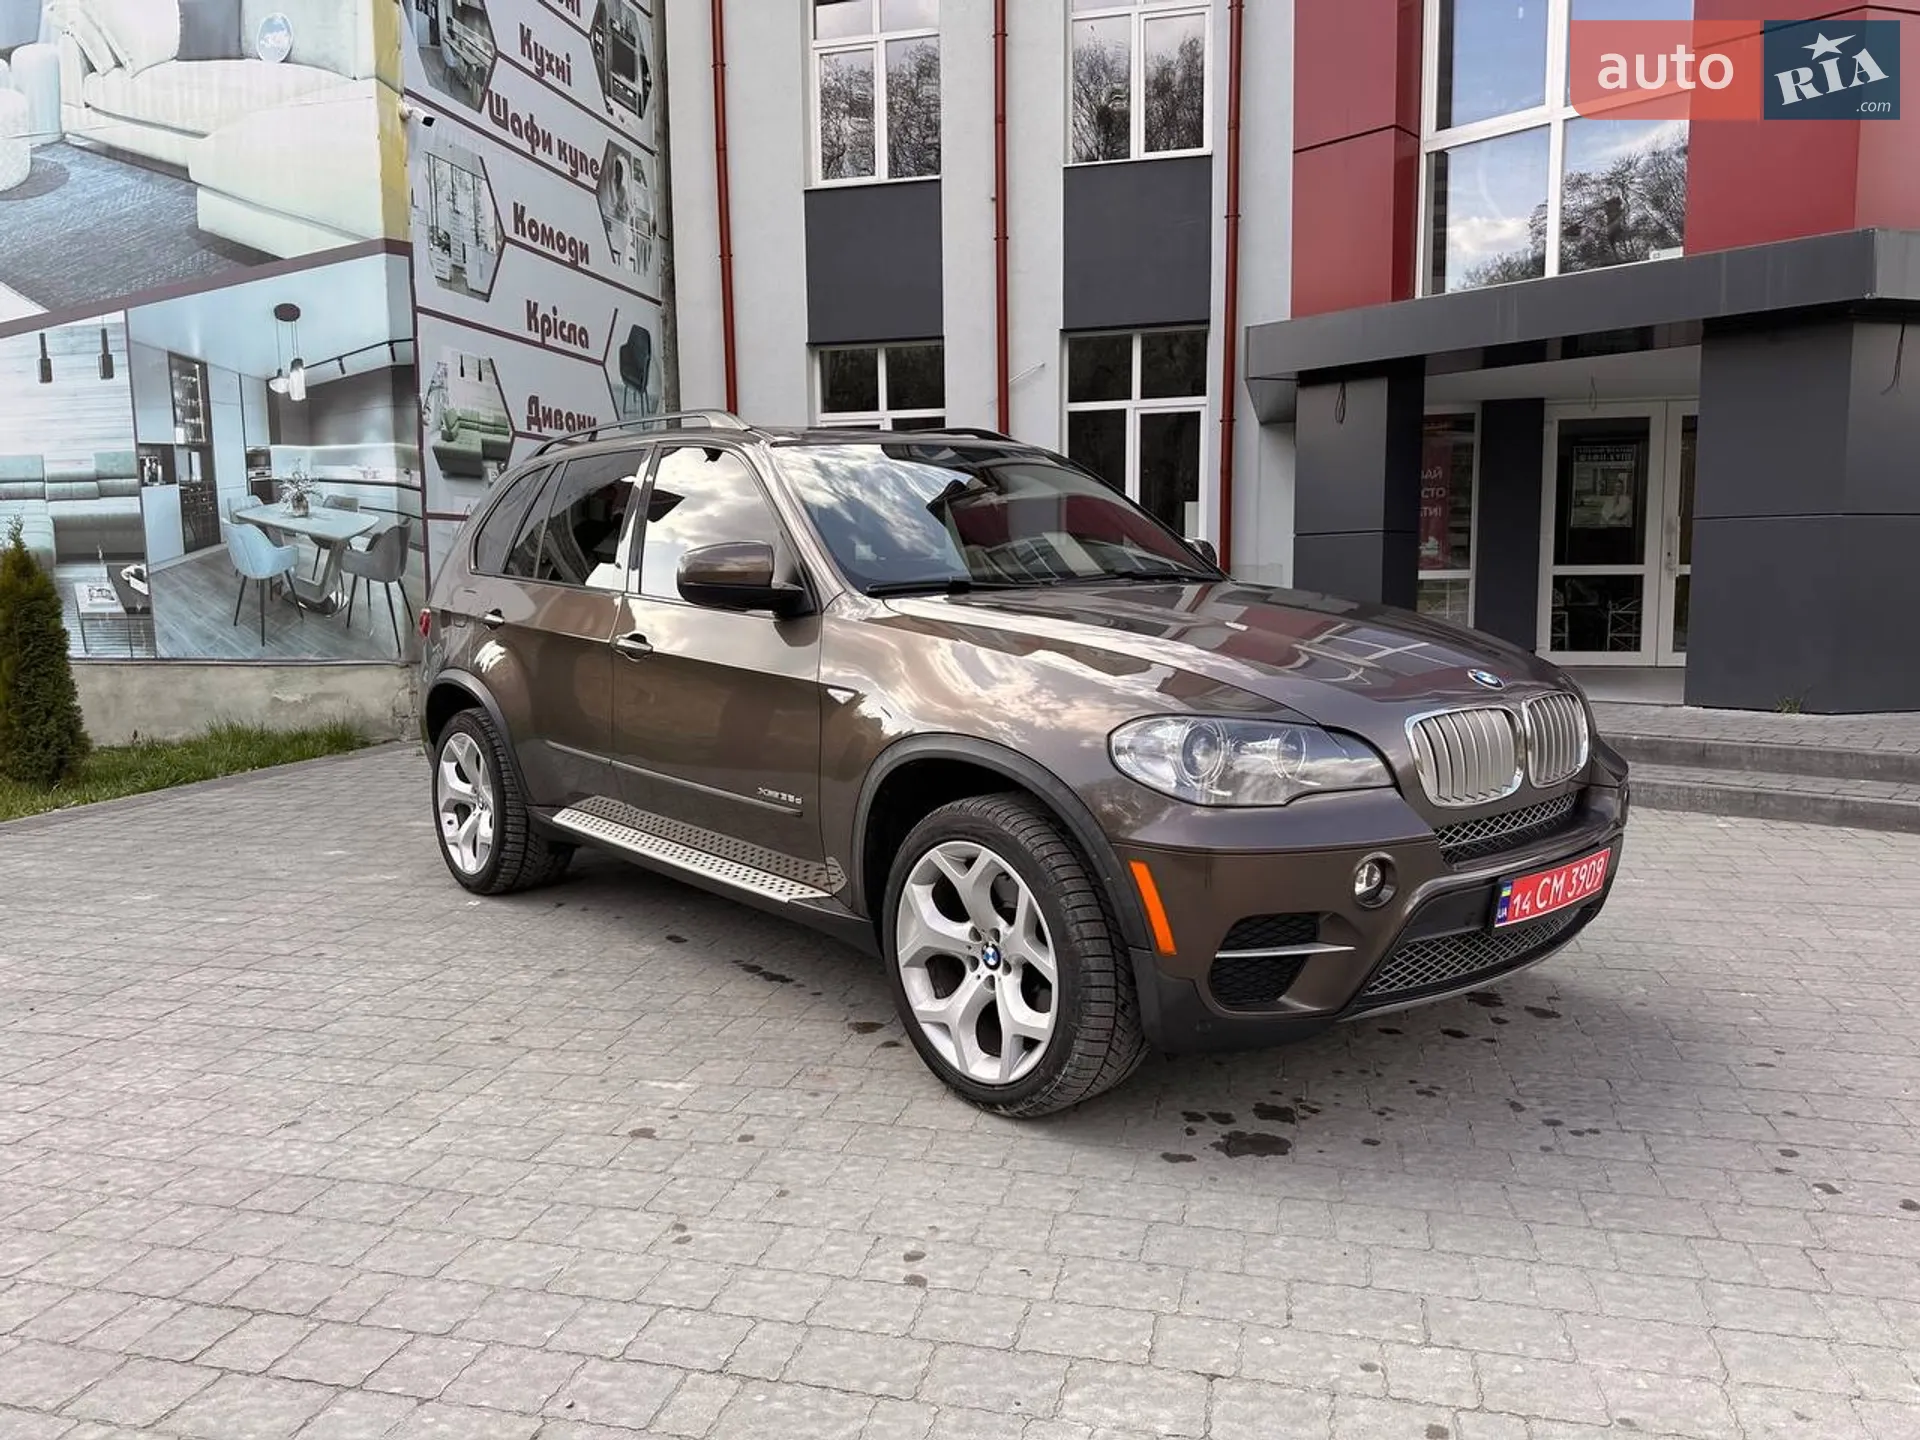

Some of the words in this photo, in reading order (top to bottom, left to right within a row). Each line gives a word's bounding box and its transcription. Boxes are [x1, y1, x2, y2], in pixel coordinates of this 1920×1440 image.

[519, 22, 572, 87] Кухні
[487, 90, 553, 155] Шафи
[557, 139, 599, 181] купе
[513, 201, 589, 269] Комоди
[526, 299, 589, 349] Крісла
[526, 395, 596, 432] Дивани
[1513, 891, 1532, 917] 14
[1536, 872, 1566, 908] CM
[1567, 857, 1605, 898] 3909
